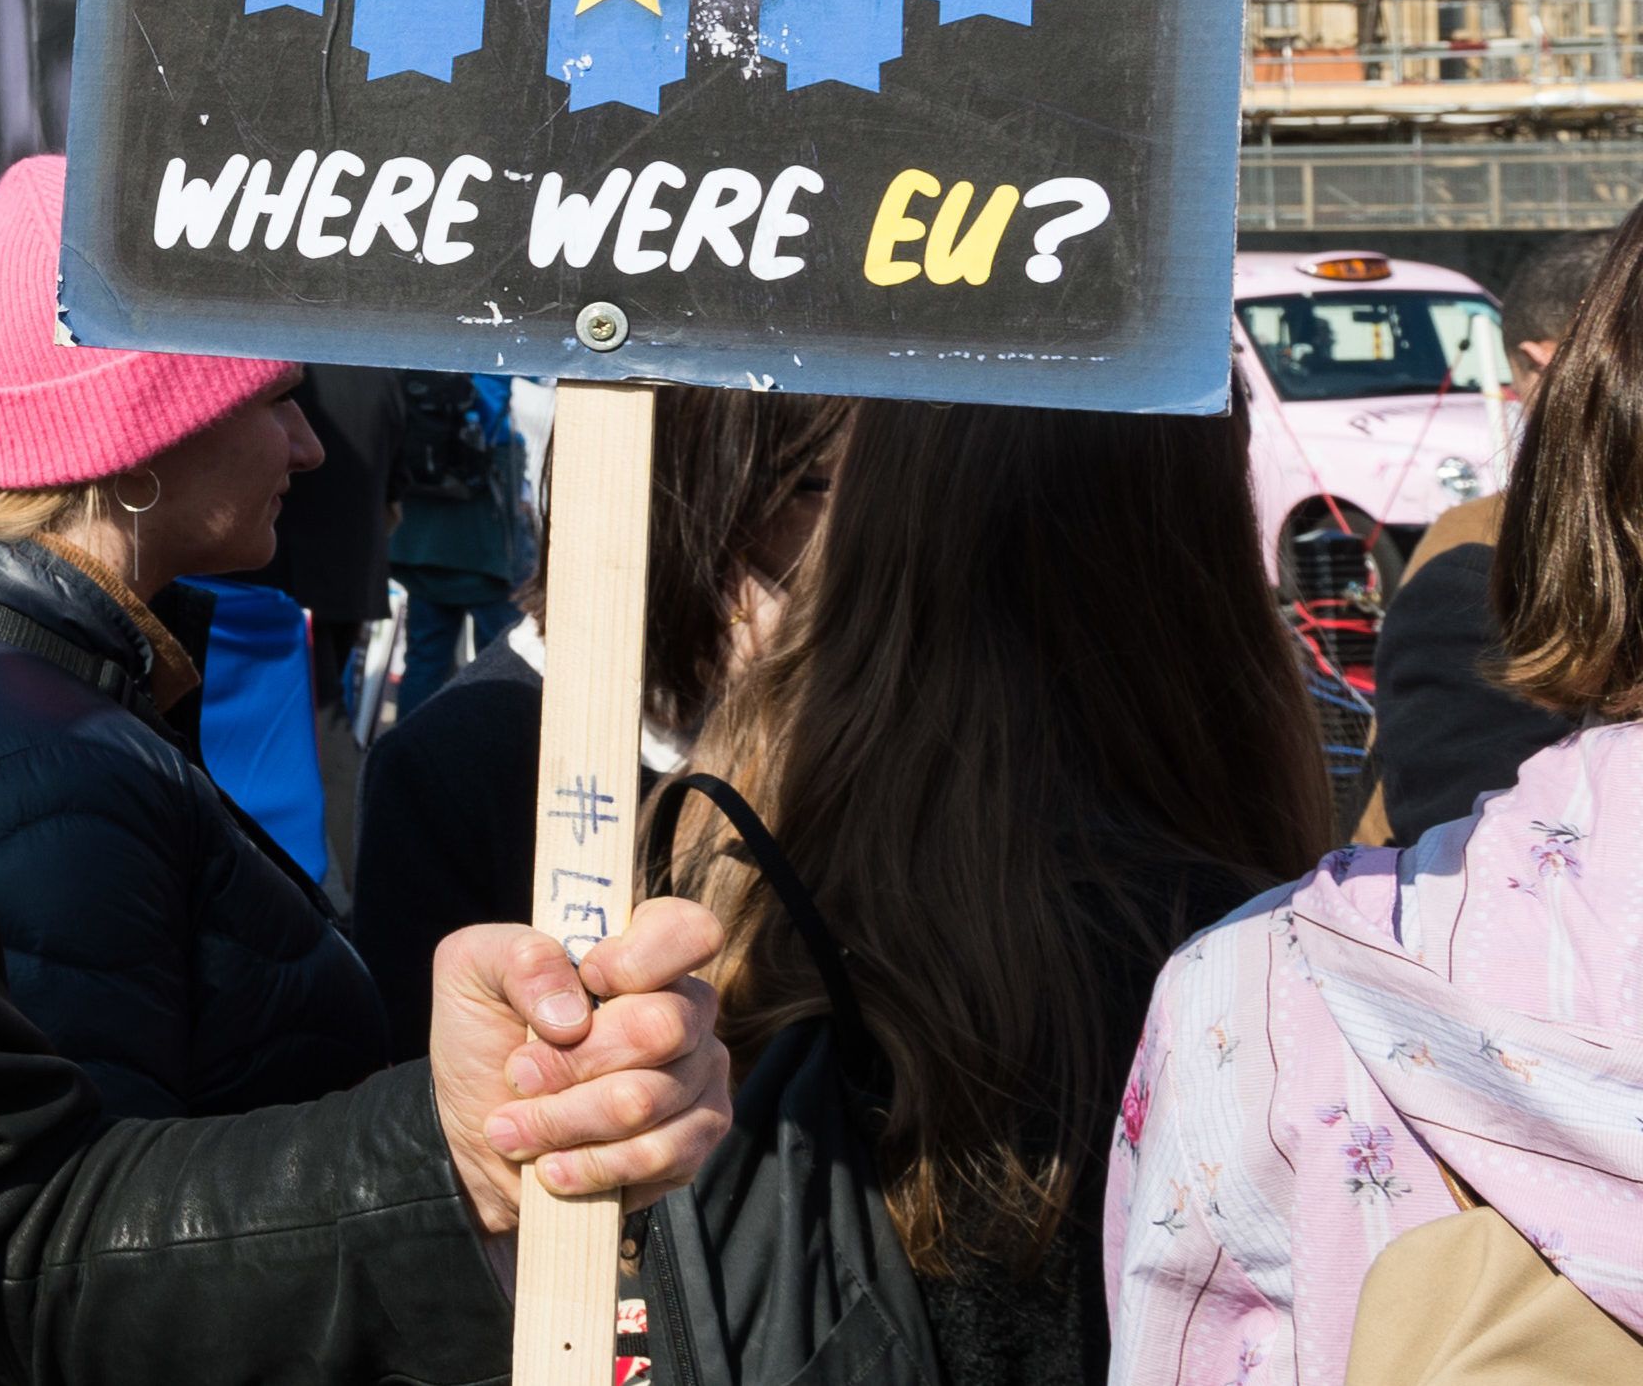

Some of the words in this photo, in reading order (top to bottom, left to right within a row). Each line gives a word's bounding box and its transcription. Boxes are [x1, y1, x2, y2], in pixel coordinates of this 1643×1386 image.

[153, 150, 493, 266] WHERE
[528, 161, 825, 281] WERE
[863, 169, 1111, 287] EU?
